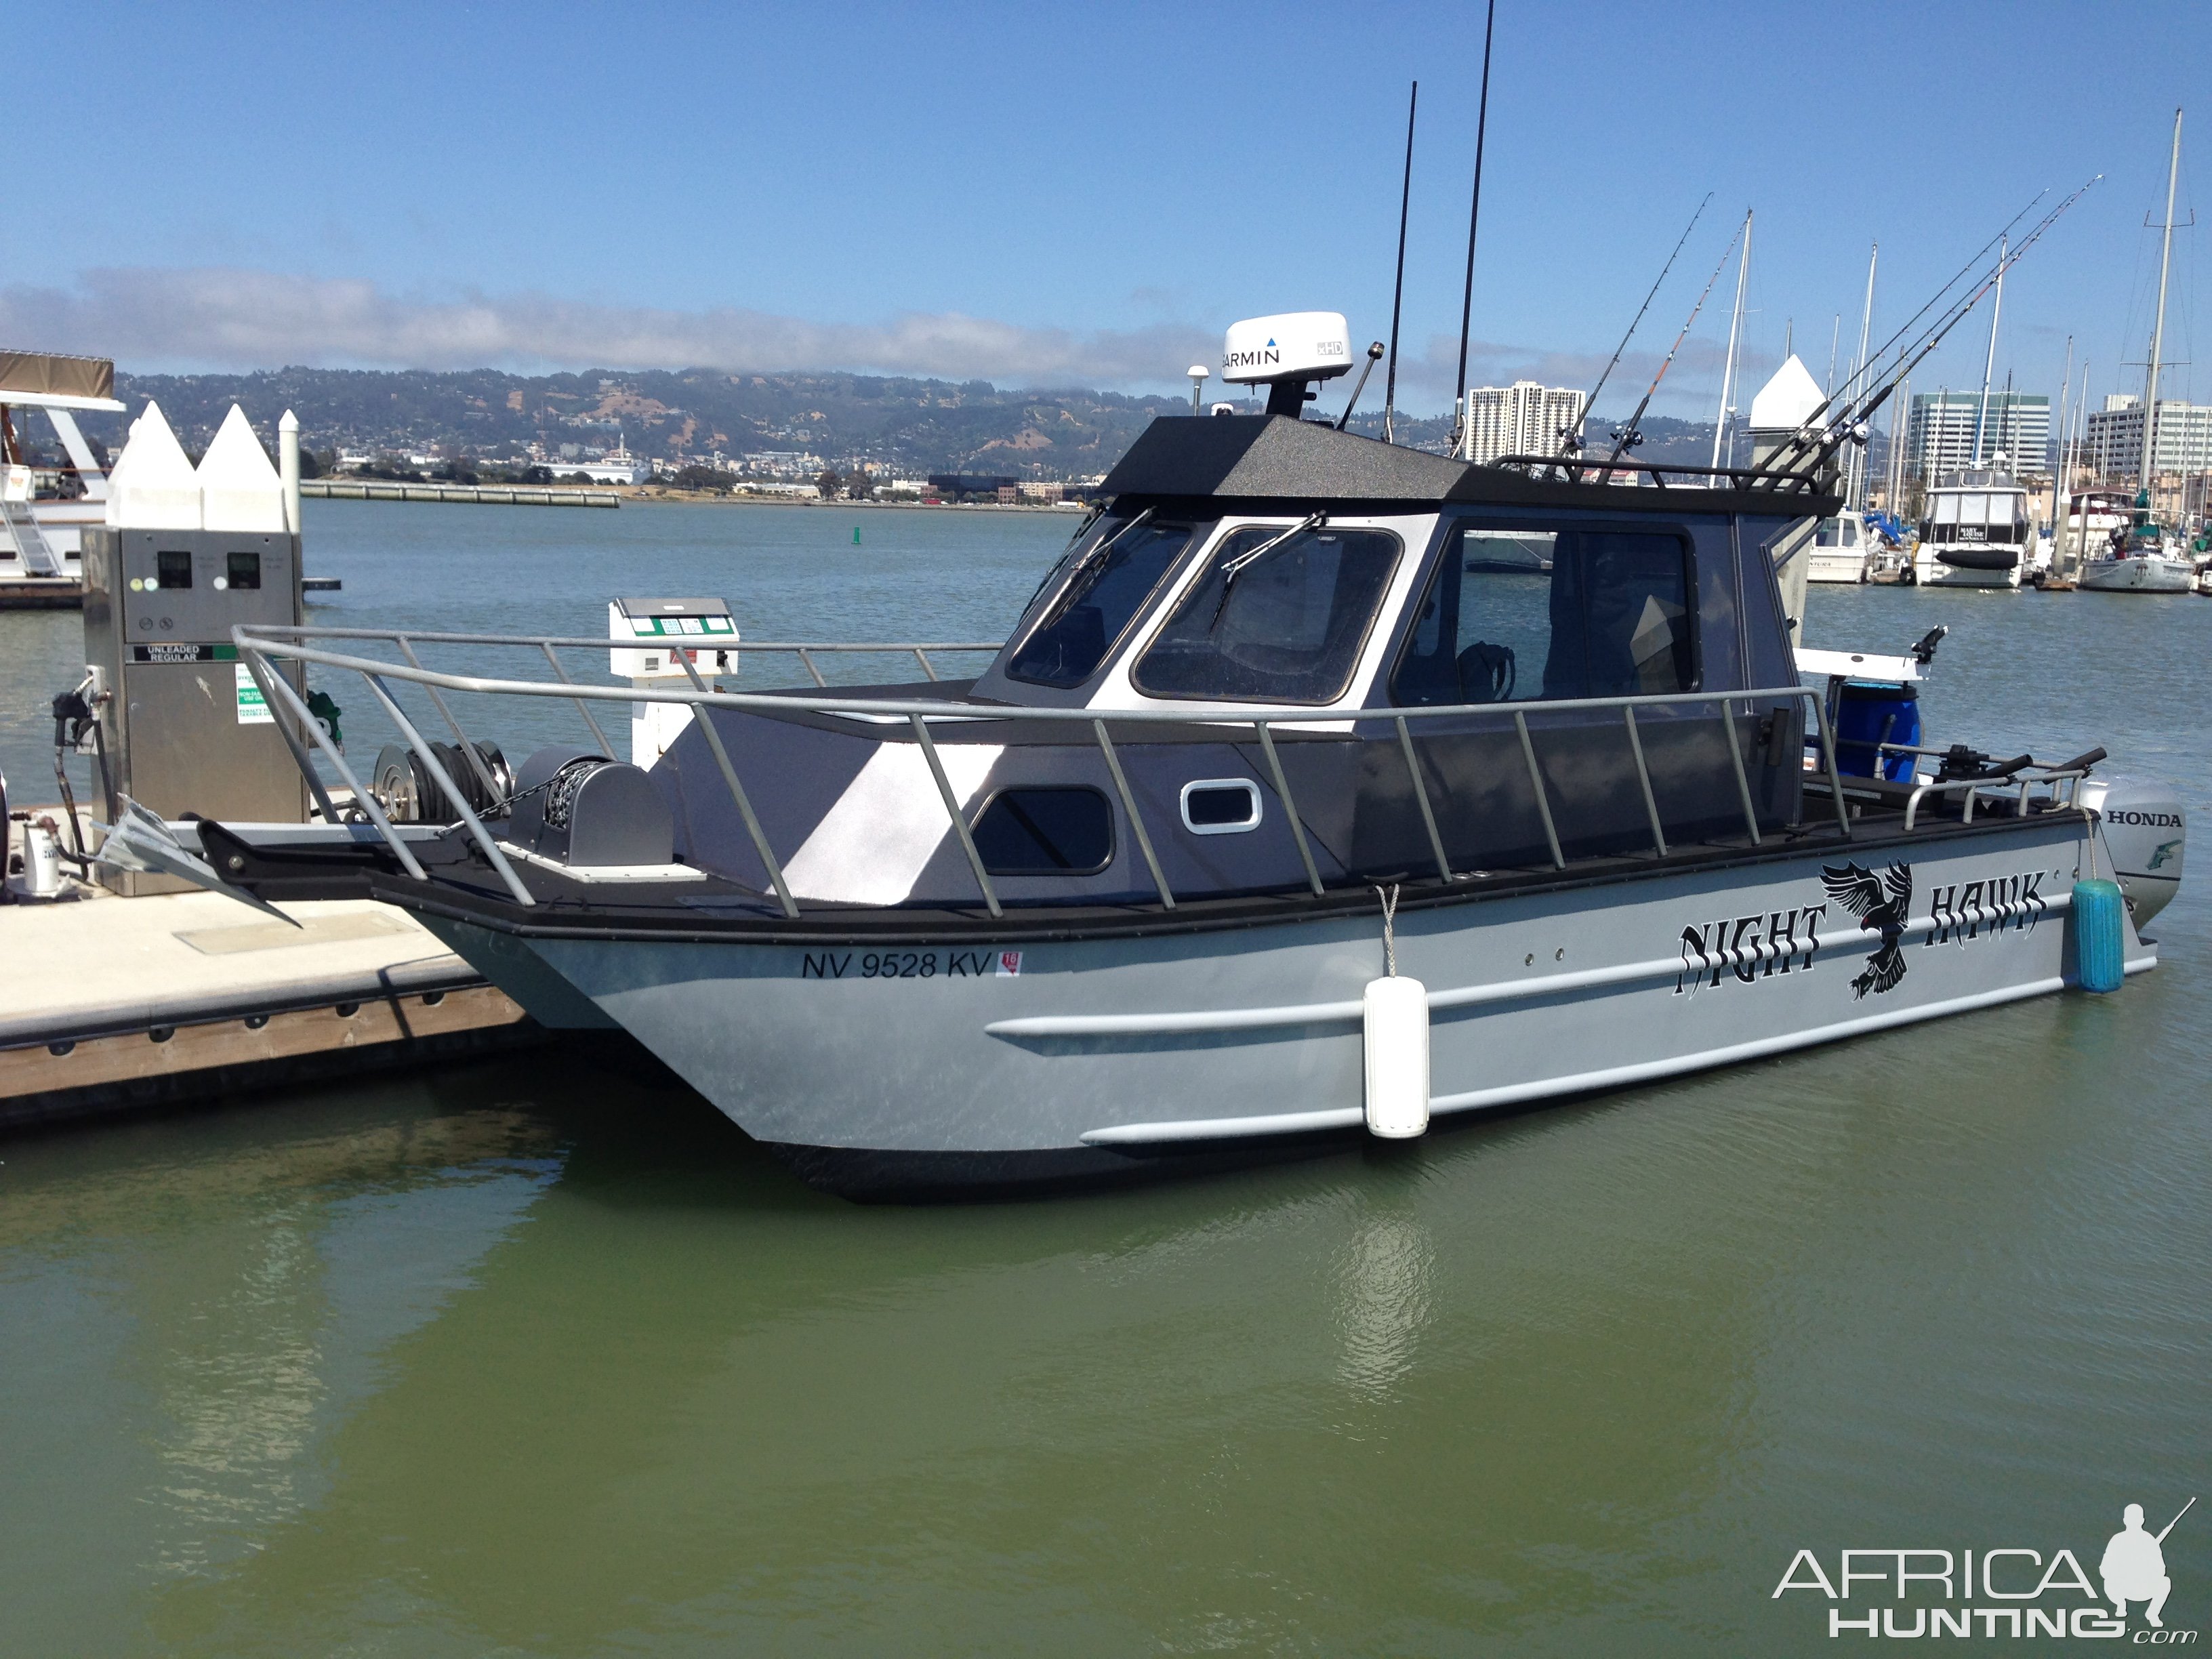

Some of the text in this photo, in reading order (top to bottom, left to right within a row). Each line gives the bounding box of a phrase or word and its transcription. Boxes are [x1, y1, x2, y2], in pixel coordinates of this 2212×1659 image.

[1317, 342, 1343, 355] xHD
[147, 645, 199, 653] UNLEADED
[2107, 810, 2182, 827] HONDA
[1672, 869, 2048, 1000] NIGHT HAWK
[802, 952, 992, 978] NV 9528 KV
